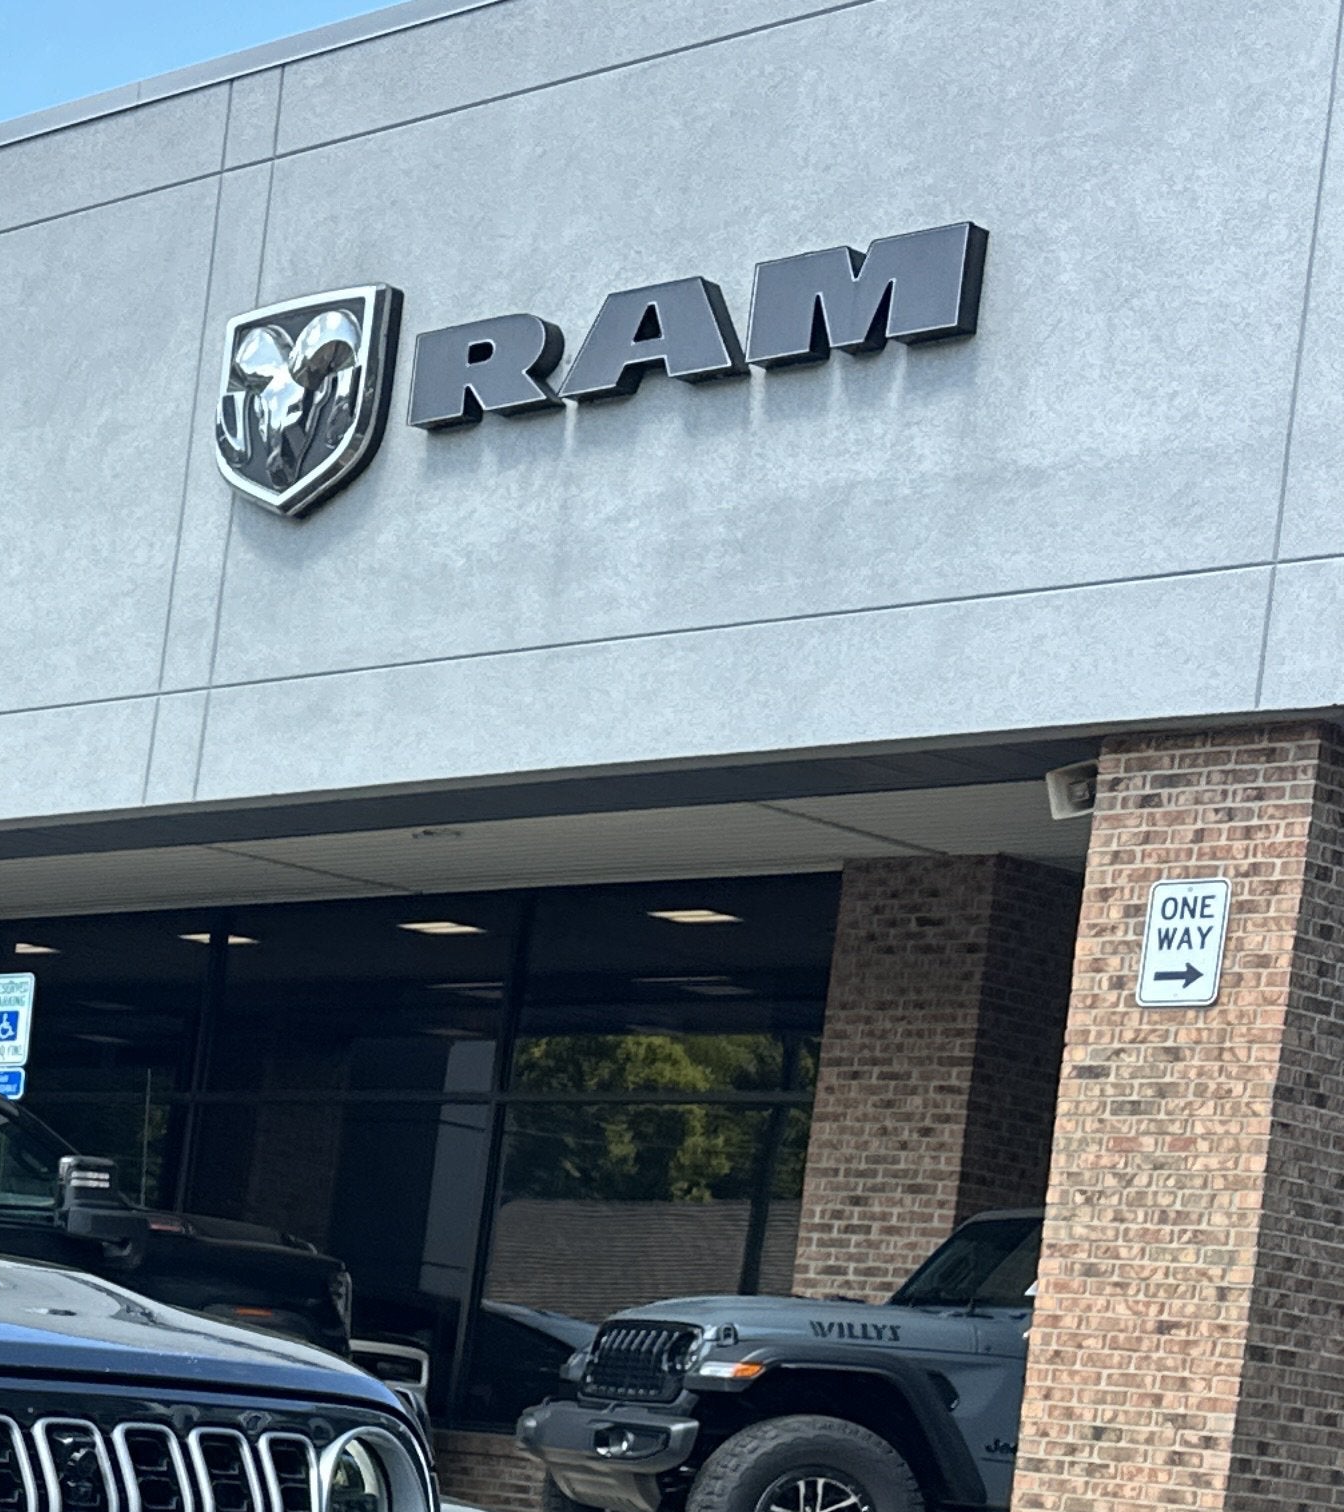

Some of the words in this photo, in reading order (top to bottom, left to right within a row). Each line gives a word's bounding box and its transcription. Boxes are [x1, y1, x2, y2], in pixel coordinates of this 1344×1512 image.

[406, 221, 989, 430] RAM
[1160, 895, 1216, 921] ONE
[1157, 925, 1214, 951] WAY
[809, 1320, 901, 1342] WILLYS
